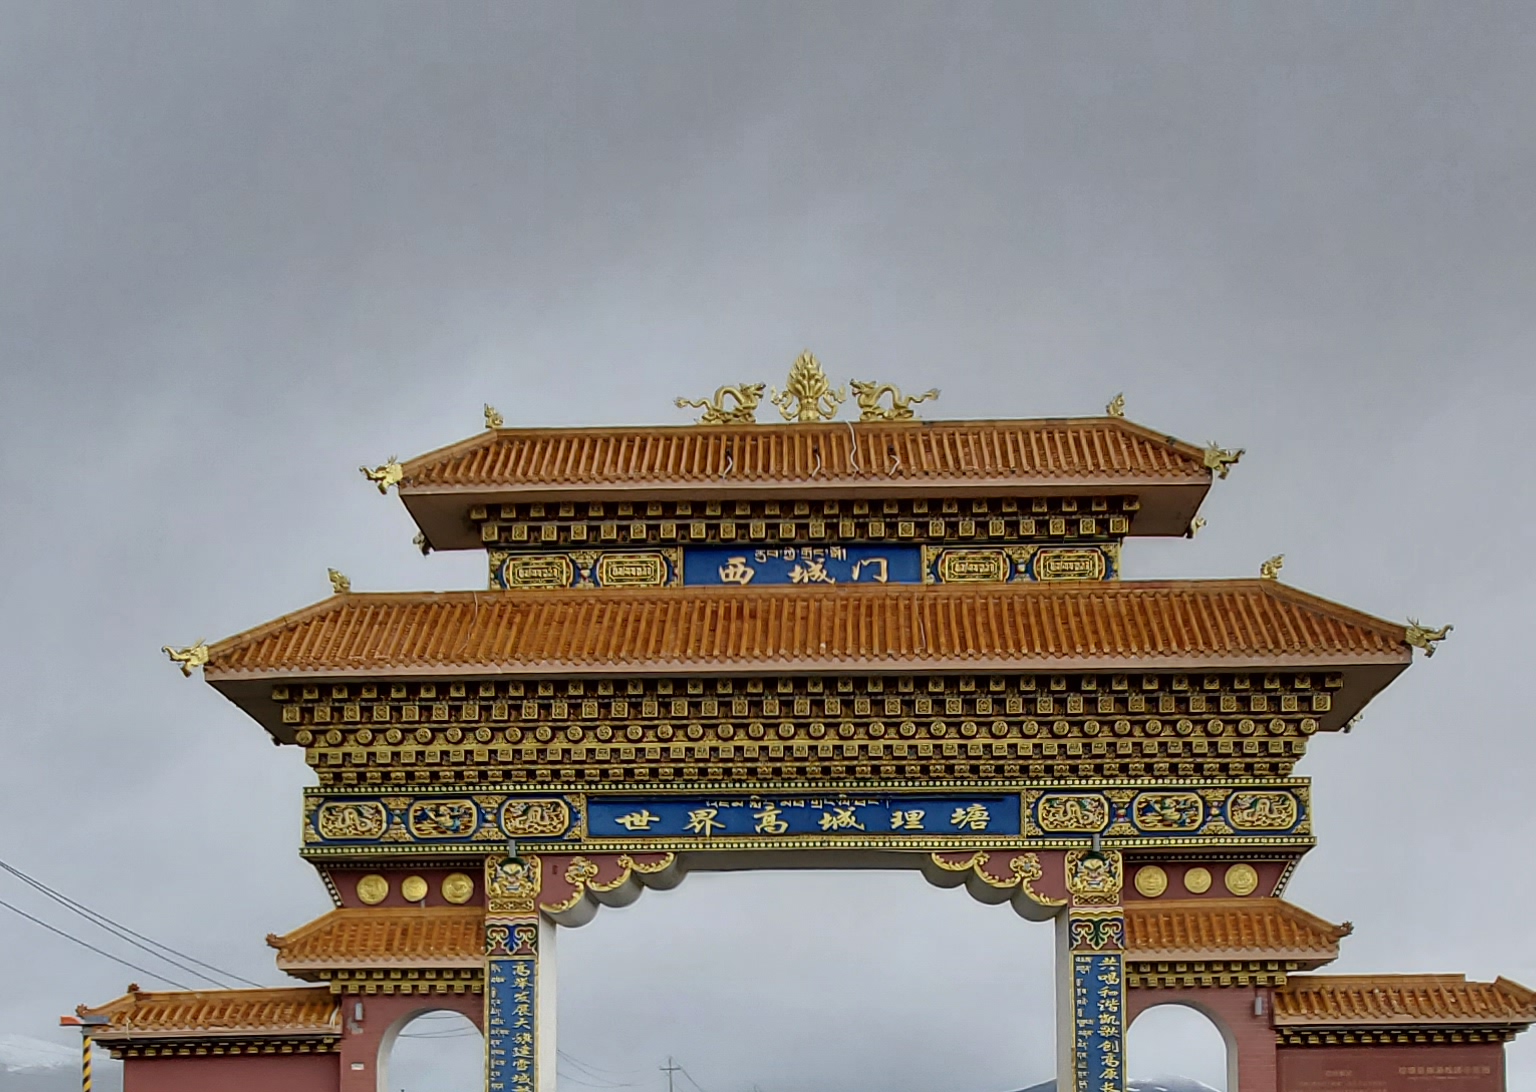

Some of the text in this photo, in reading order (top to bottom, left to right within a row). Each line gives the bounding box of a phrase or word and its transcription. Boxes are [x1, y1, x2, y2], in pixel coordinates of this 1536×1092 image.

[719, 557, 888, 584] 西城门
[615, 804, 991, 836] 世界高城理塘
